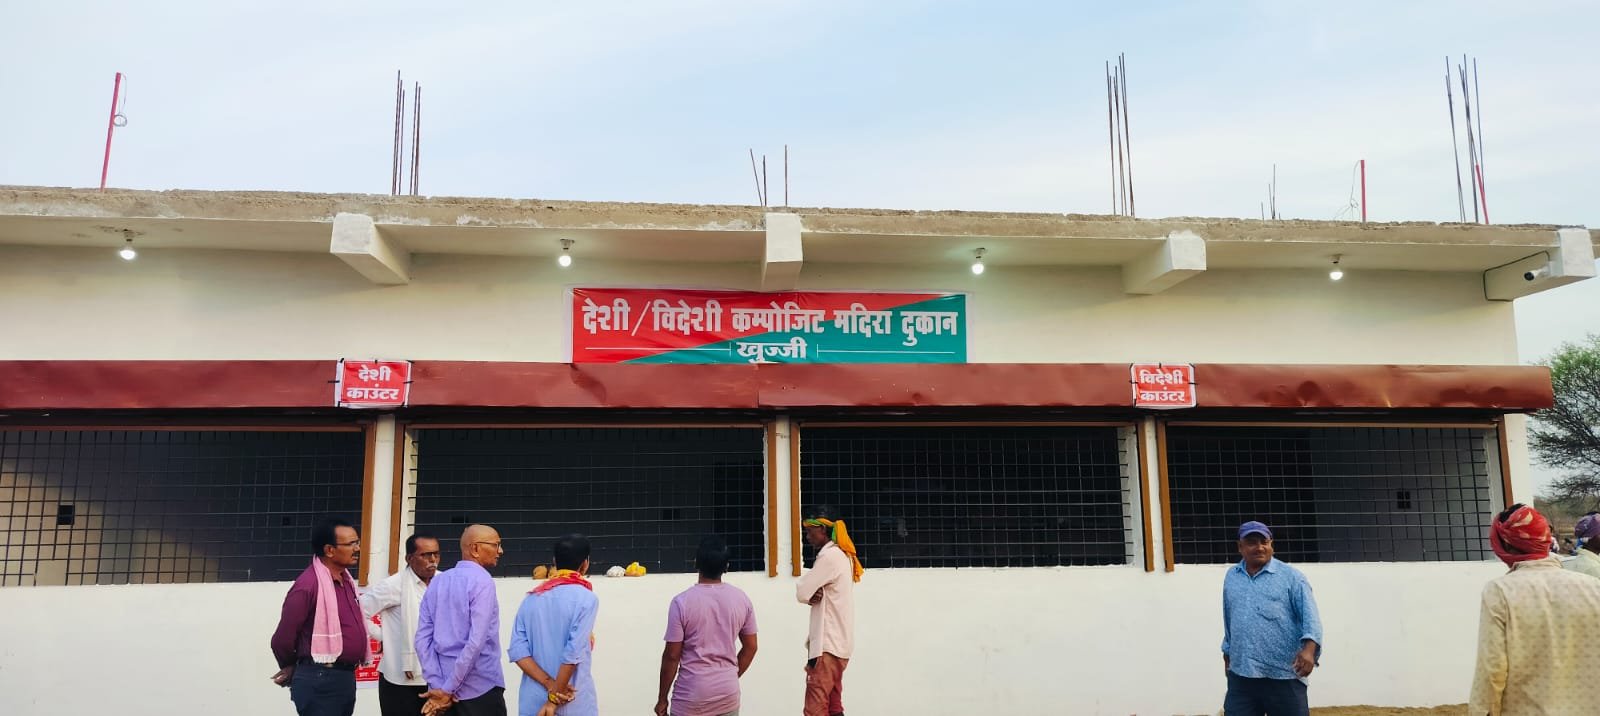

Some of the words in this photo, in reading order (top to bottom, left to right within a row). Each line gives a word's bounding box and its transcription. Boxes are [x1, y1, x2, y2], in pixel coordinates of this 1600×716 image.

[731, 301, 825, 333] कम्पोजिट
[833, 303, 892, 338] मदिरा
[900, 311, 958, 347] दुकान
[736, 337, 807, 363] खुज्जी
[358, 364, 391, 382] देशी
[1140, 368, 1183, 385] विदेशी
[346, 383, 400, 400] काउंटर
[1140, 386, 1185, 402] काउंटर
